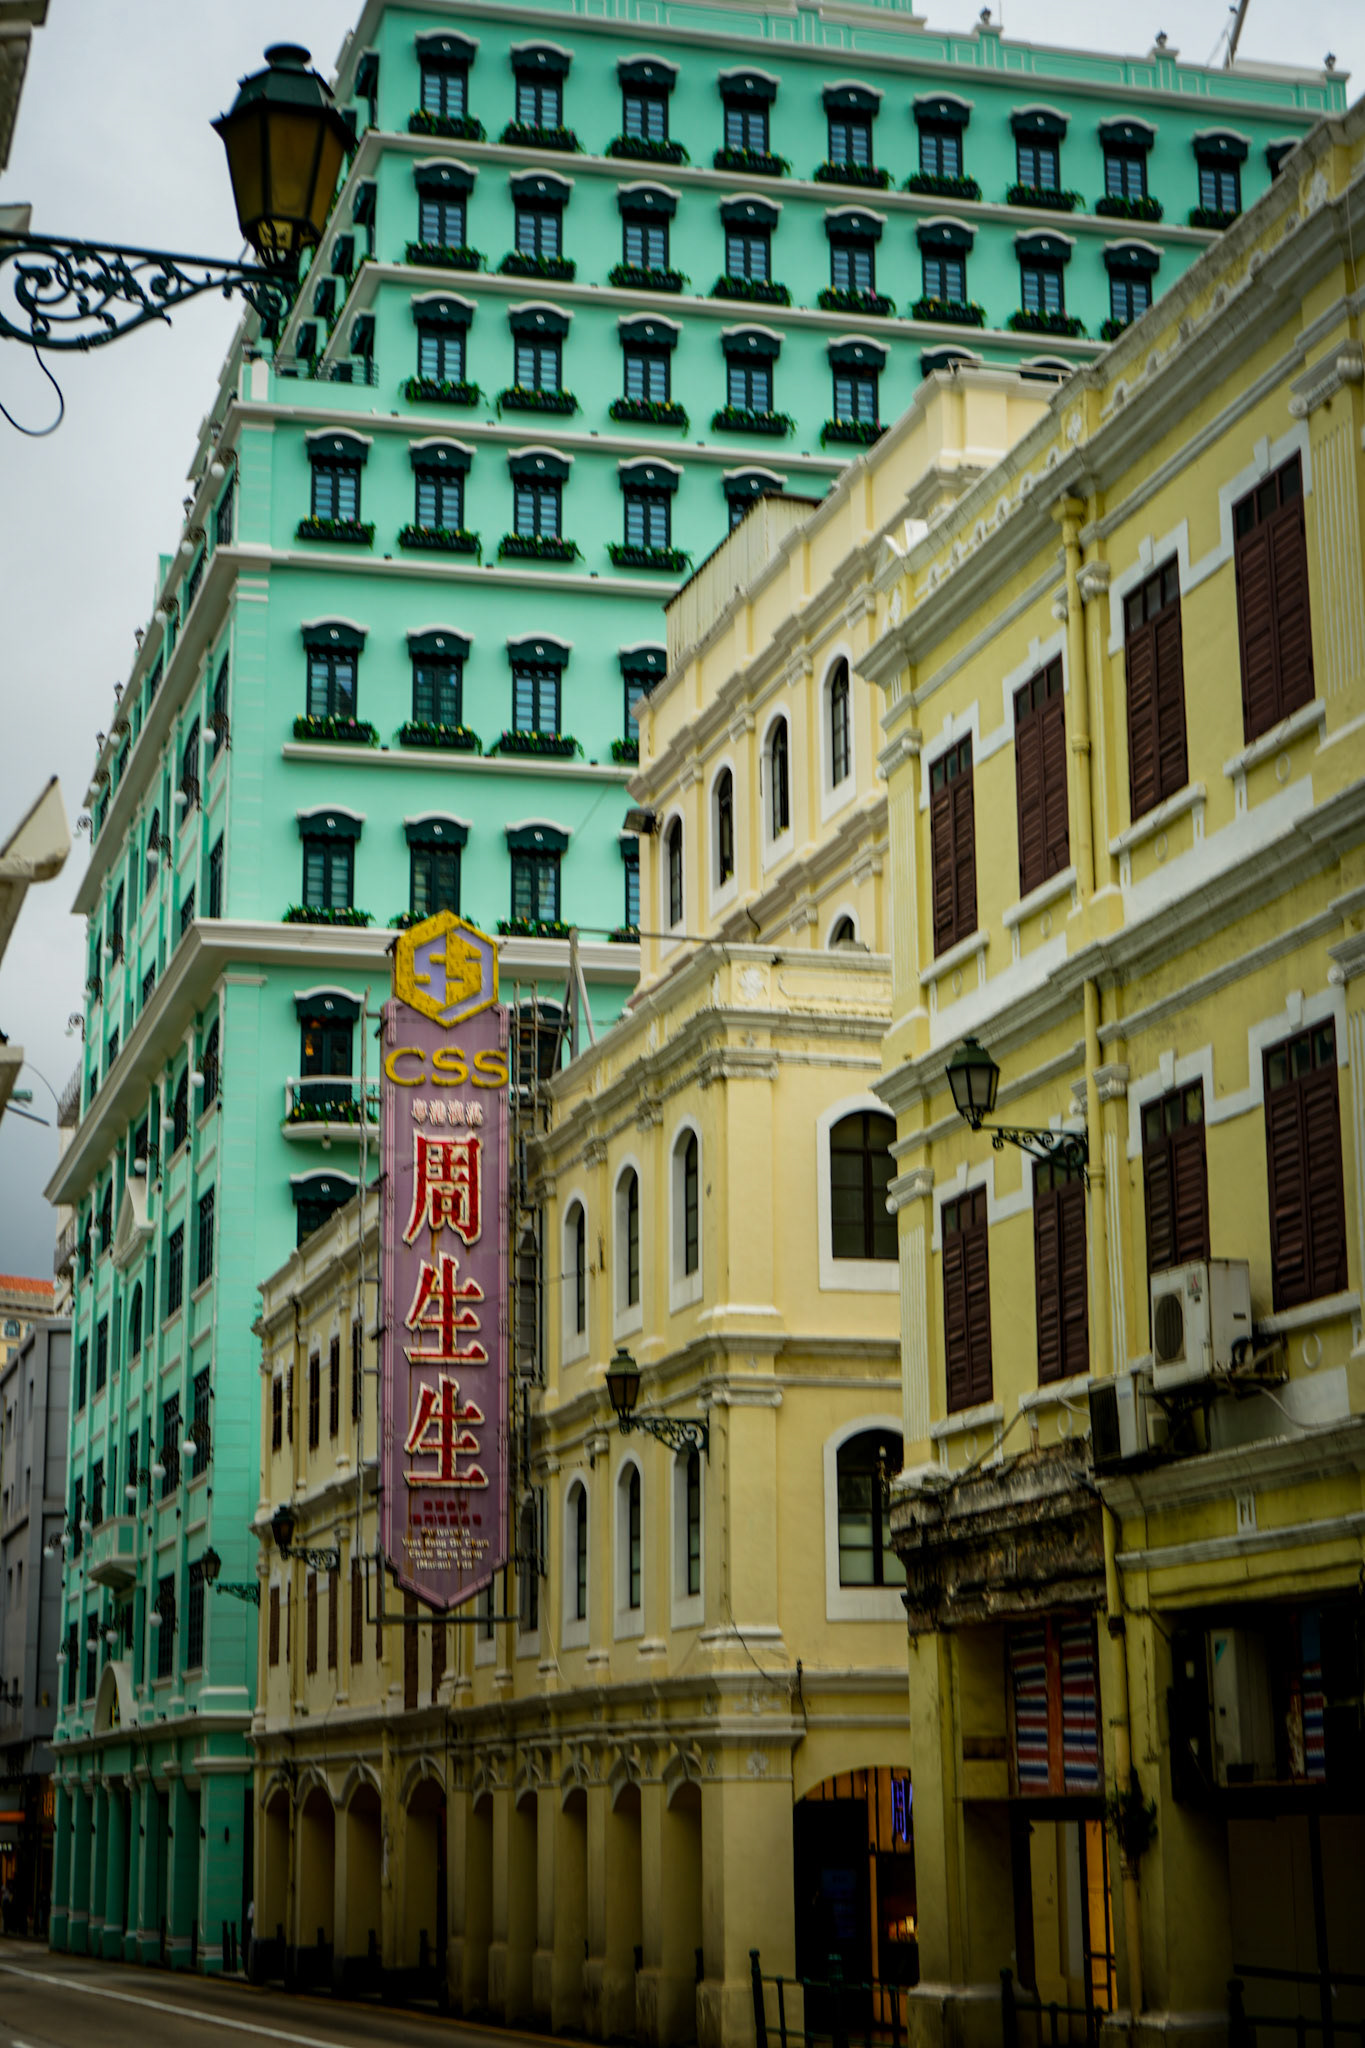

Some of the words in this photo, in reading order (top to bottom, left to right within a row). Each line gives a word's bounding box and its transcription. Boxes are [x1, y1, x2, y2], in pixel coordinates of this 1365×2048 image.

[384, 1047, 509, 1089] CSS
[402, 1127, 489, 1489] 周生生
